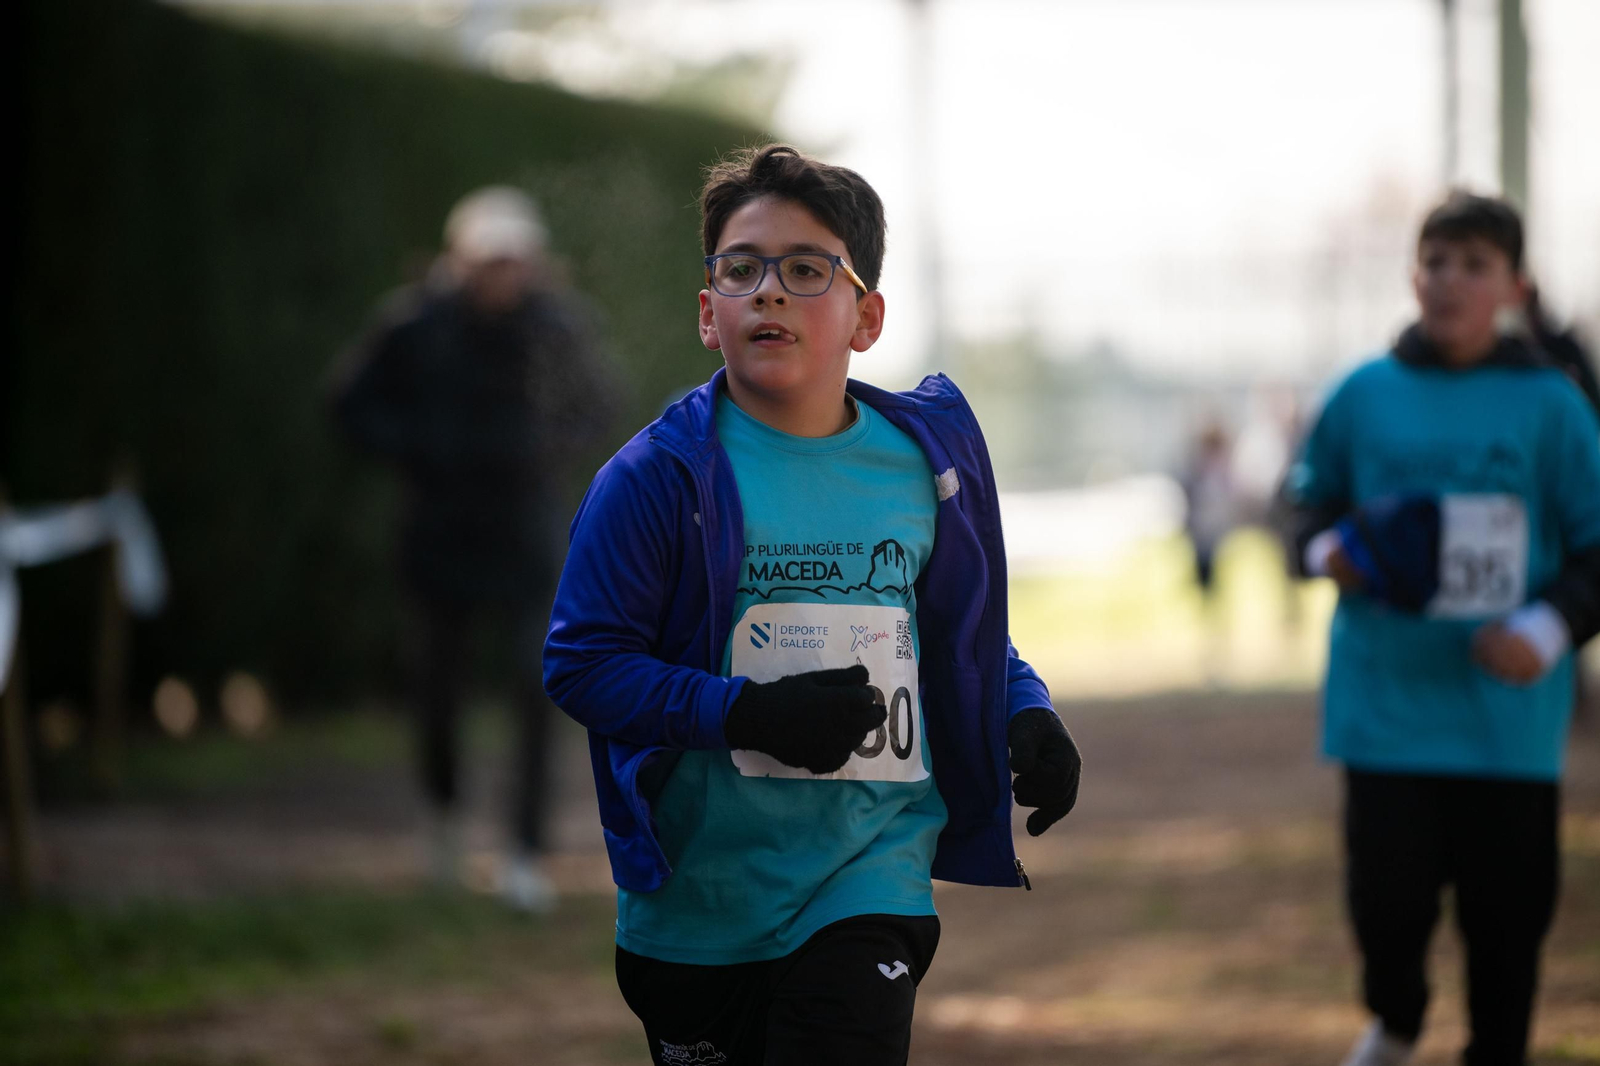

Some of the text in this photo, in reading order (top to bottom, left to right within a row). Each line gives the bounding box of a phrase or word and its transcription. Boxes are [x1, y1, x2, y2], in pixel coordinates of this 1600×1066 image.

[758, 541, 842, 557] PLURILINGÜE
[847, 542, 864, 555] DE
[749, 561, 843, 582] MACEDA
[780, 625, 829, 637] DEPORTE
[780, 638, 825, 649] GALEGO
